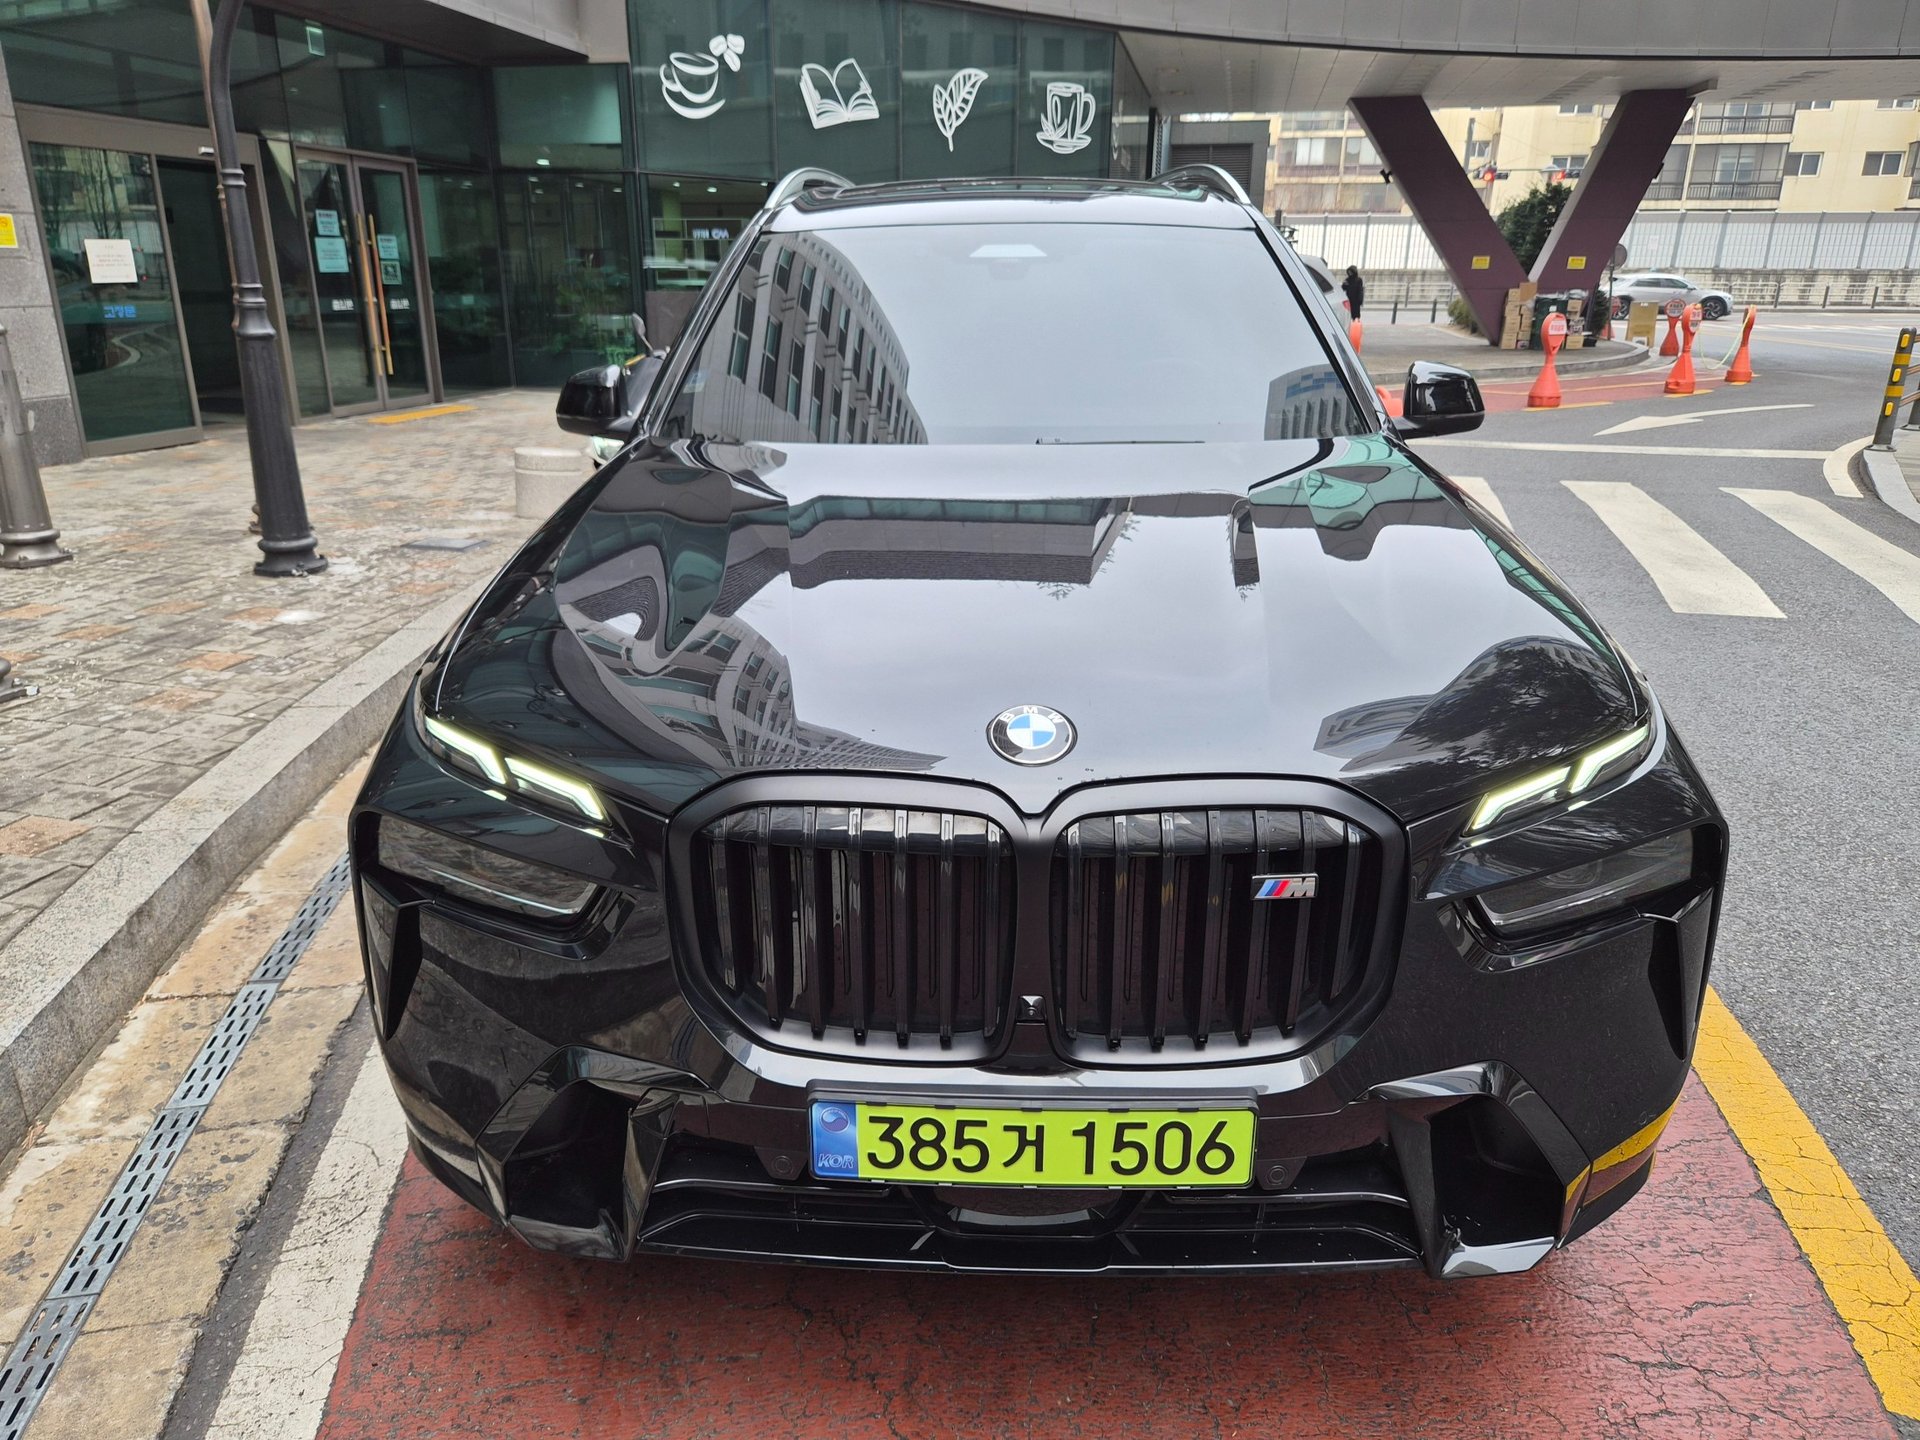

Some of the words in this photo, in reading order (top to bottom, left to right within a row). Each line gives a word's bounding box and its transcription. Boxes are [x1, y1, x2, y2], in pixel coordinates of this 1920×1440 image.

[103, 304, 137, 318] 고정문
[998, 705, 1065, 724] BMW
[866, 1114, 1046, 1174] 385거
[1071, 1119, 1236, 1176] 1506
[817, 1153, 855, 1169] KOR
